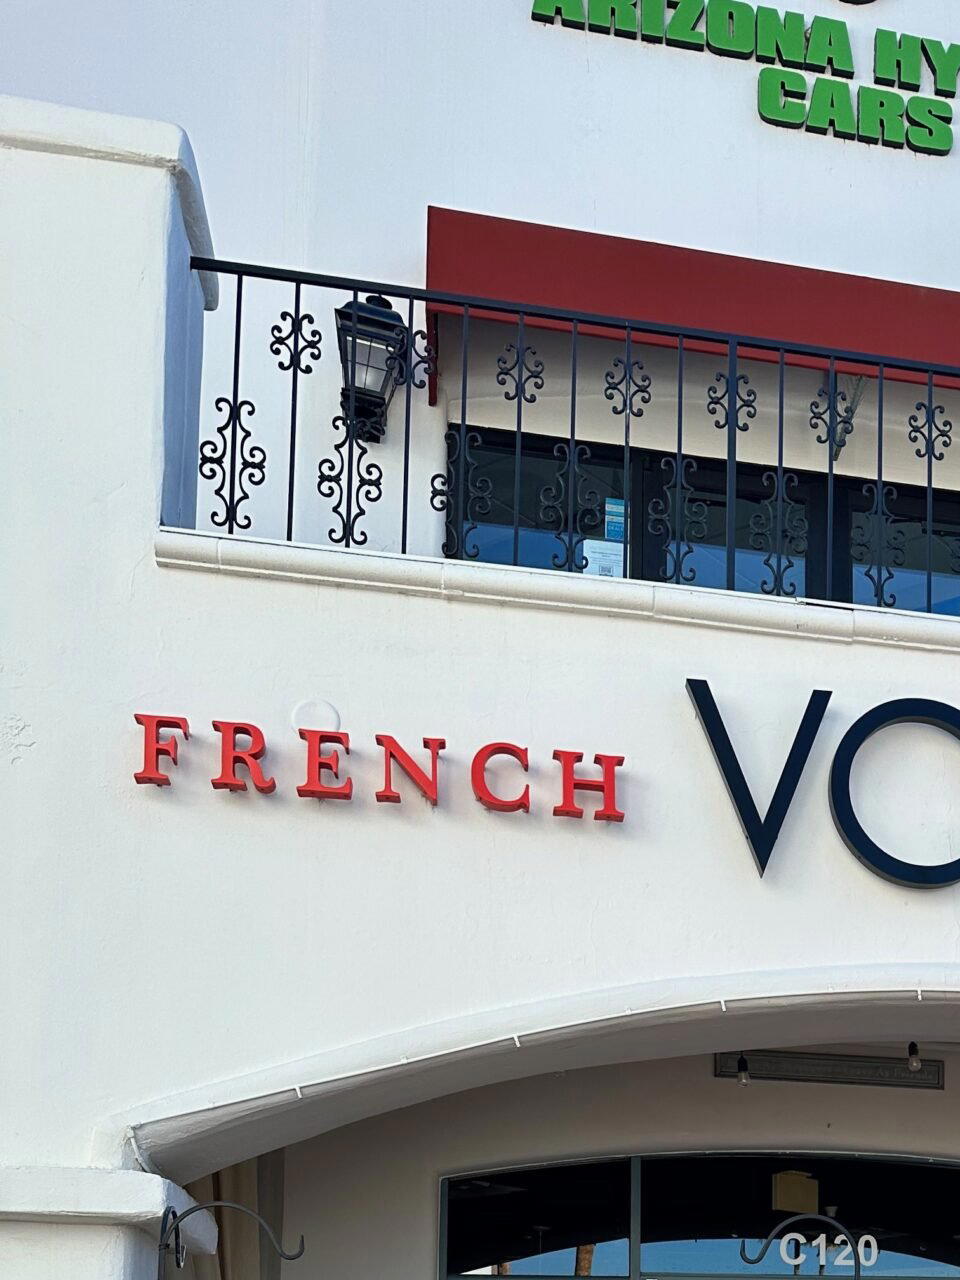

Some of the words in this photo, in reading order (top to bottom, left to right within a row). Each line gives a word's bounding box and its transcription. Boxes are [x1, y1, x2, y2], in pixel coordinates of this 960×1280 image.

[756, 66, 955, 157] CARS
[133, 713, 626, 824] FRENCH
[779, 1232, 879, 1267] C120
